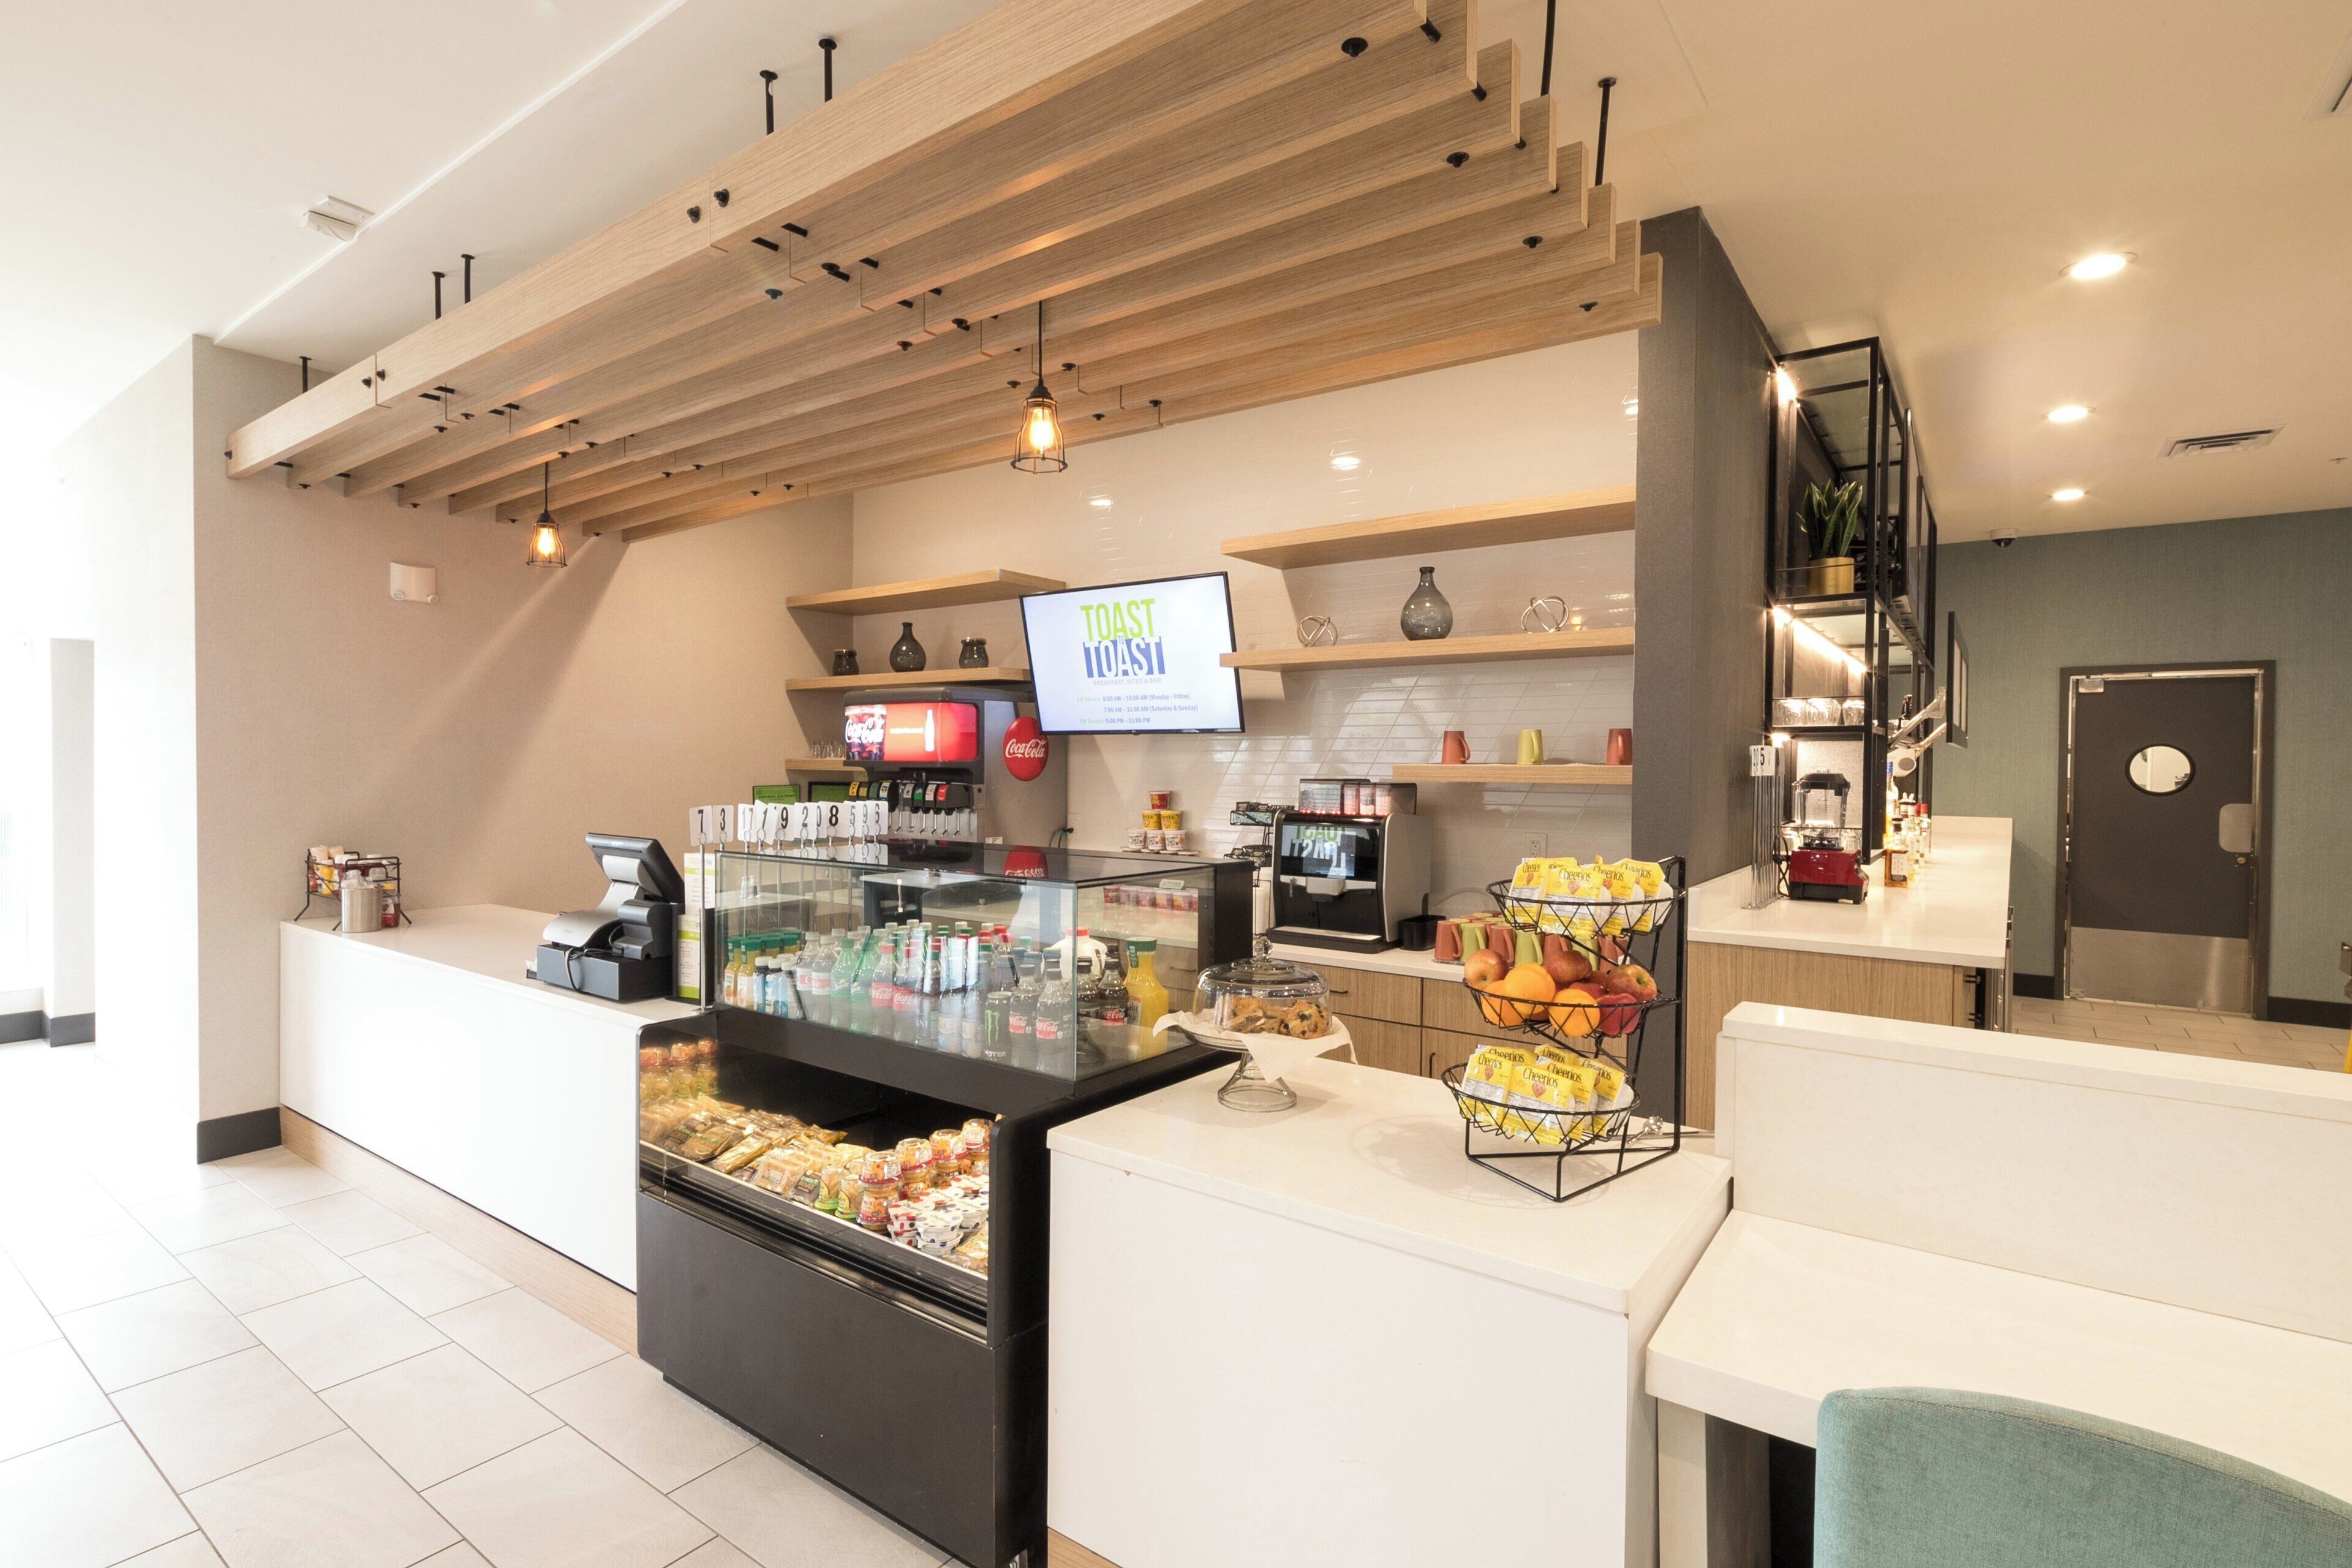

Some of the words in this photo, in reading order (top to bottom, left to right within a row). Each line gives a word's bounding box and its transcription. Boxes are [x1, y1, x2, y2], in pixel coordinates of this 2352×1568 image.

[1080, 598, 1155, 641] TOAST
[1118, 635, 1125, 644] TO
[1085, 632, 1161, 678] TOAST
[1005, 738, 1047, 758] Coca-Cola
[1760, 747, 1765, 766] 5
[698, 809, 704, 832] 7
[720, 807, 726, 831] 3
[802, 805, 809, 827] 2
[829, 805, 839, 826] 8
[875, 803, 880, 824] 6
[1559, 868, 1592, 882] Cheerios
[1593, 865, 1625, 882] Cheerios
[1621, 862, 1652, 879] Cheerios
[834, 982, 850, 992] Sprite
[1478, 1053, 1502, 1069] Cheerios
[1542, 1046, 1566, 1063] Cheerios
[1523, 1067, 1559, 1088] Cheerios
[1547, 1063, 1581, 1083] Cheerios
